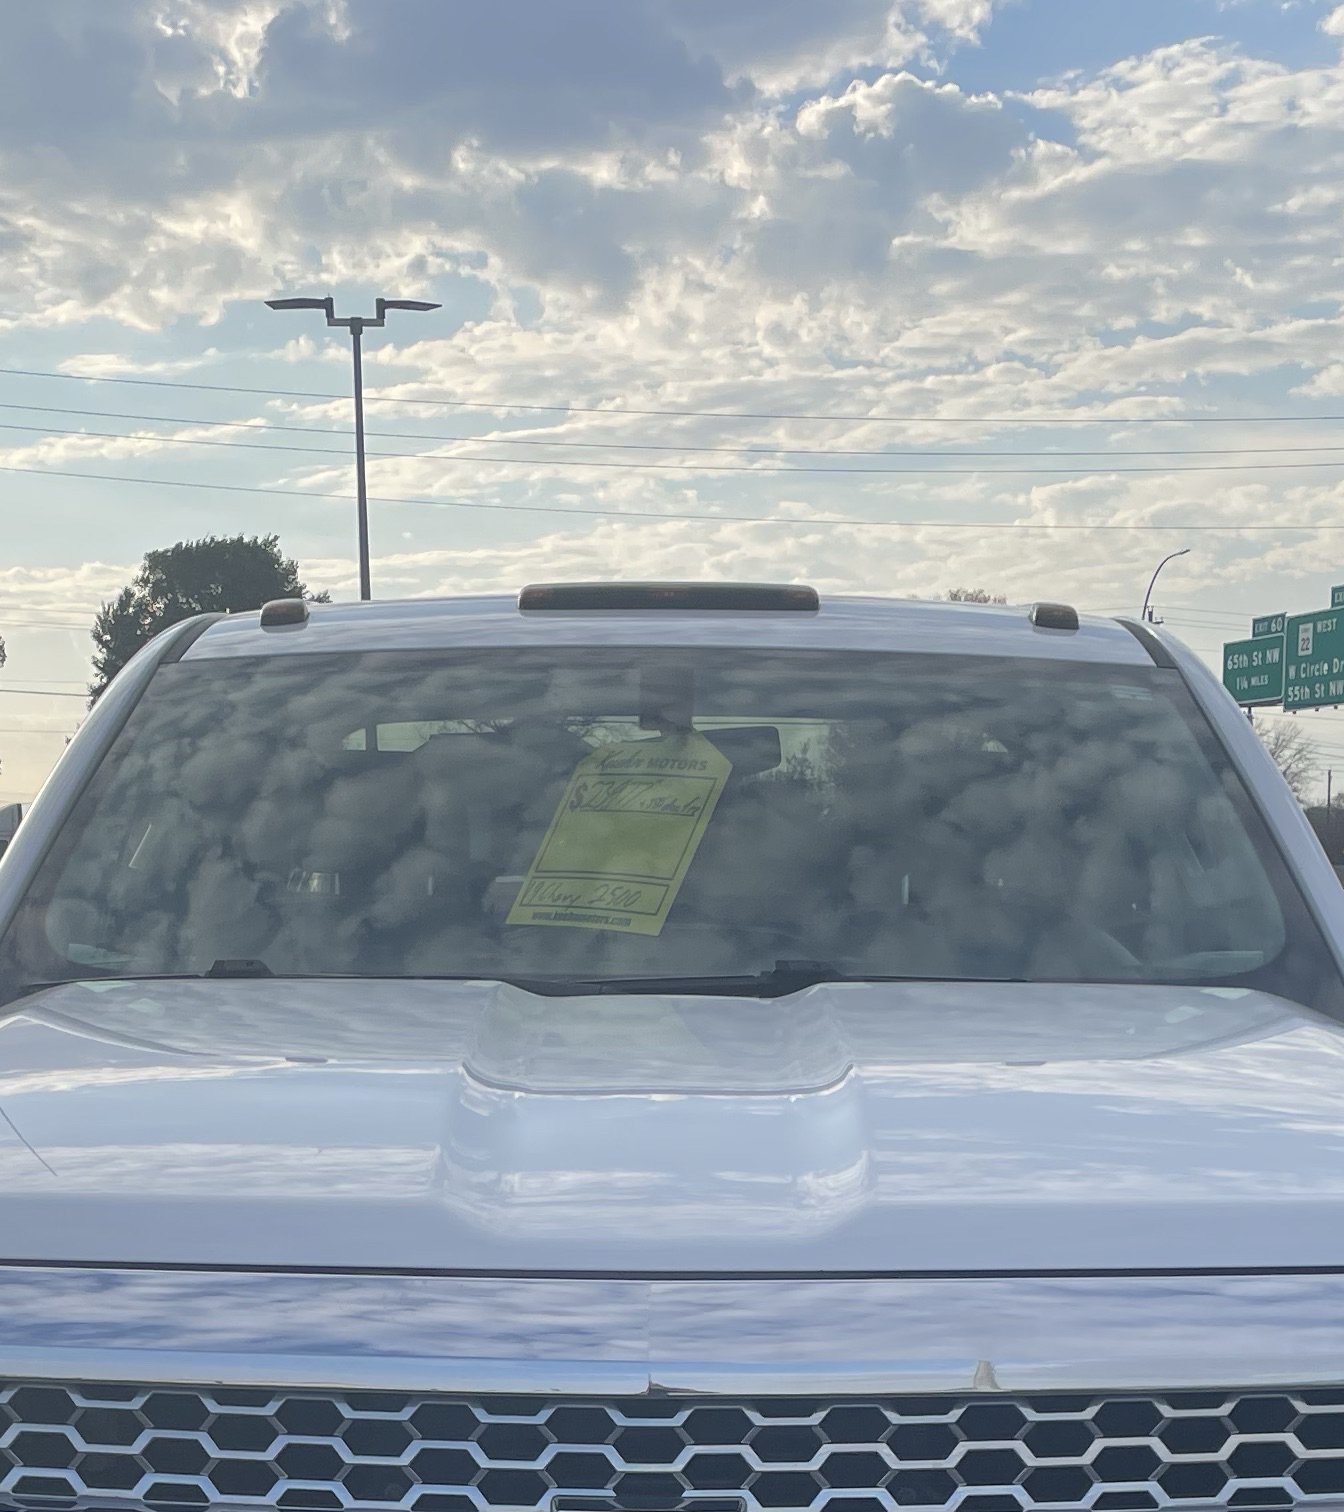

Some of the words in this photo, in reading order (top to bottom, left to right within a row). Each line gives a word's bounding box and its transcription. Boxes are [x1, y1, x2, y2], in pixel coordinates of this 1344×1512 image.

[1254, 621, 1269, 634] EXIT
[1271, 617, 1283, 632] 60
[1317, 618, 1337, 633] WEST
[1301, 637, 1311, 652] 22
[1227, 654, 1249, 670] 65th
[1252, 651, 1263, 666] St
[1266, 648, 1281, 665] NW
[1288, 665, 1297, 680] W
[1300, 661, 1329, 679] Circle
[1332, 658, 1344, 674] Dr
[1288, 685, 1311, 702] 55th
[1314, 682, 1325, 698] St
[1329, 679, 1344, 696] NW
[646, 758, 709, 771] MOTORS
[588, 884, 642, 908] 2500
